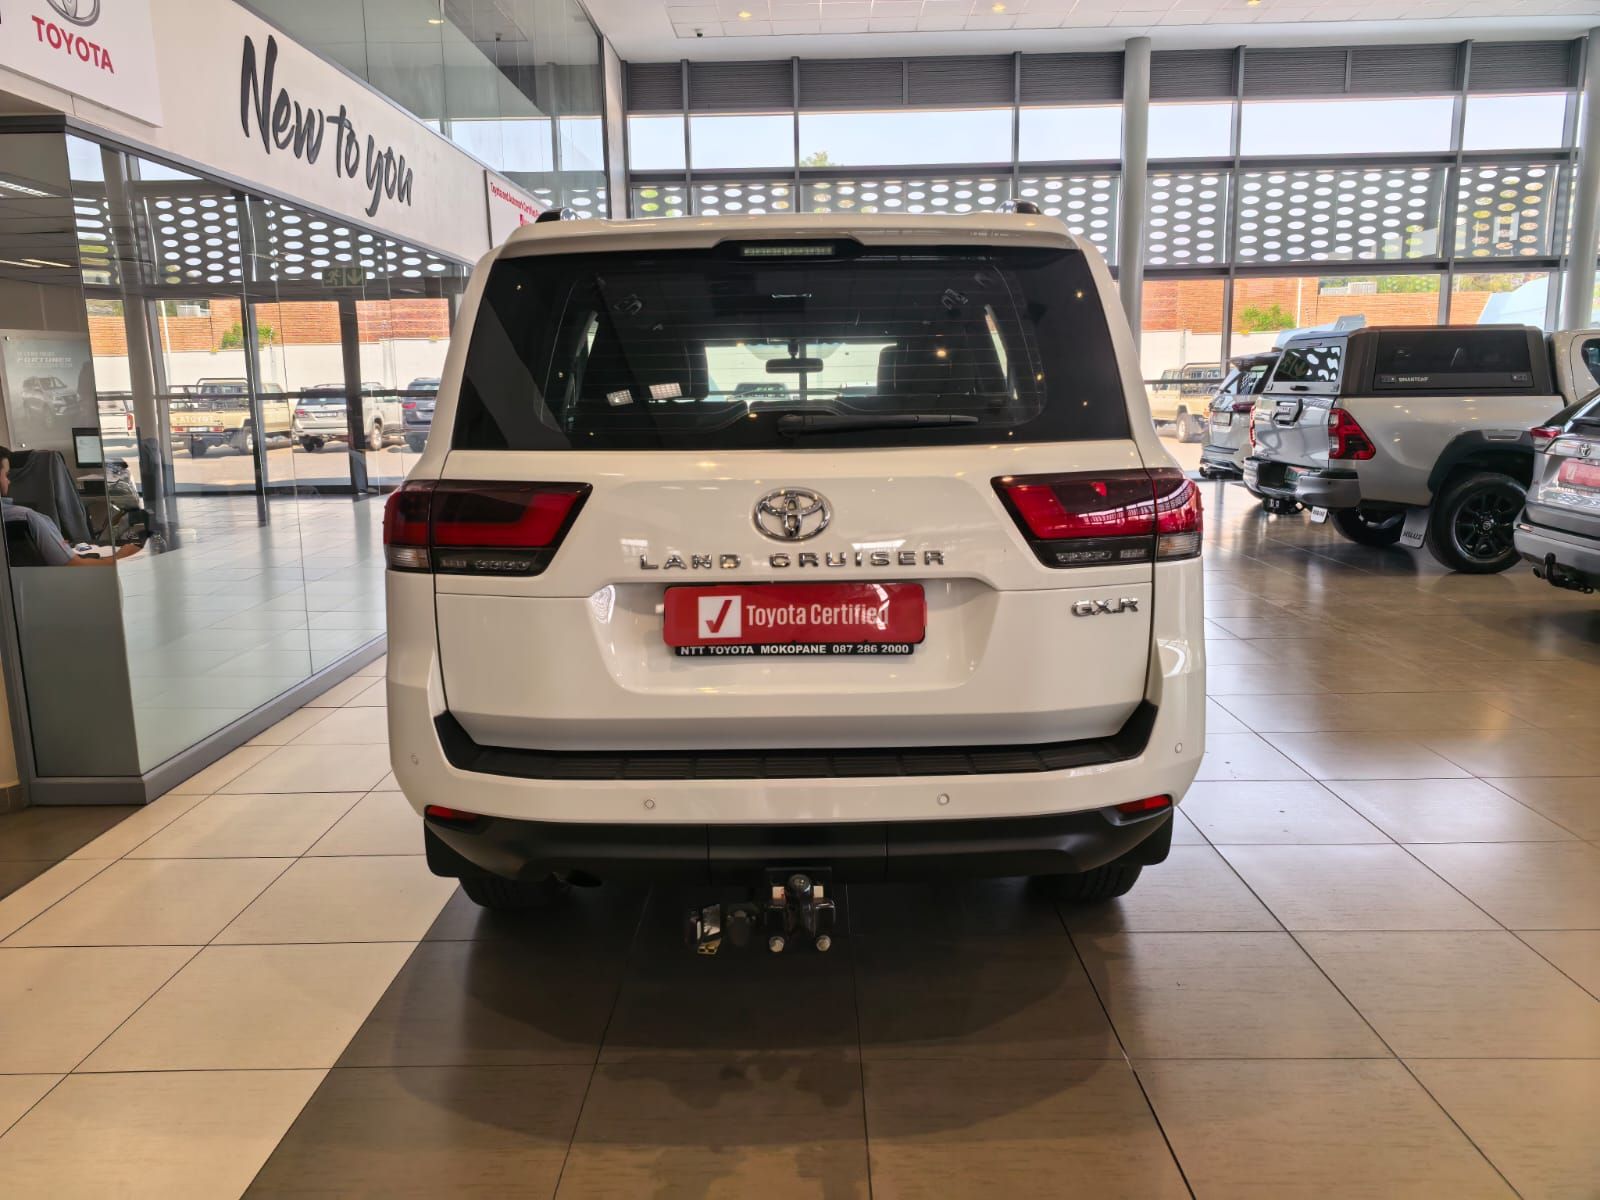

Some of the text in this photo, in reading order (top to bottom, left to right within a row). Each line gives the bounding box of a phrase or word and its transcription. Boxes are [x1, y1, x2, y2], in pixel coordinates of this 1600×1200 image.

[31, 14, 115, 75] TOYOTA
[240, 34, 413, 218] New to you
[640, 550, 945, 570] LAND CRUISER
[747, 603, 889, 628] Toyota Certified
[680, 644, 909, 656] NTT TOYOTA MOKOPANE 087 286 2000
